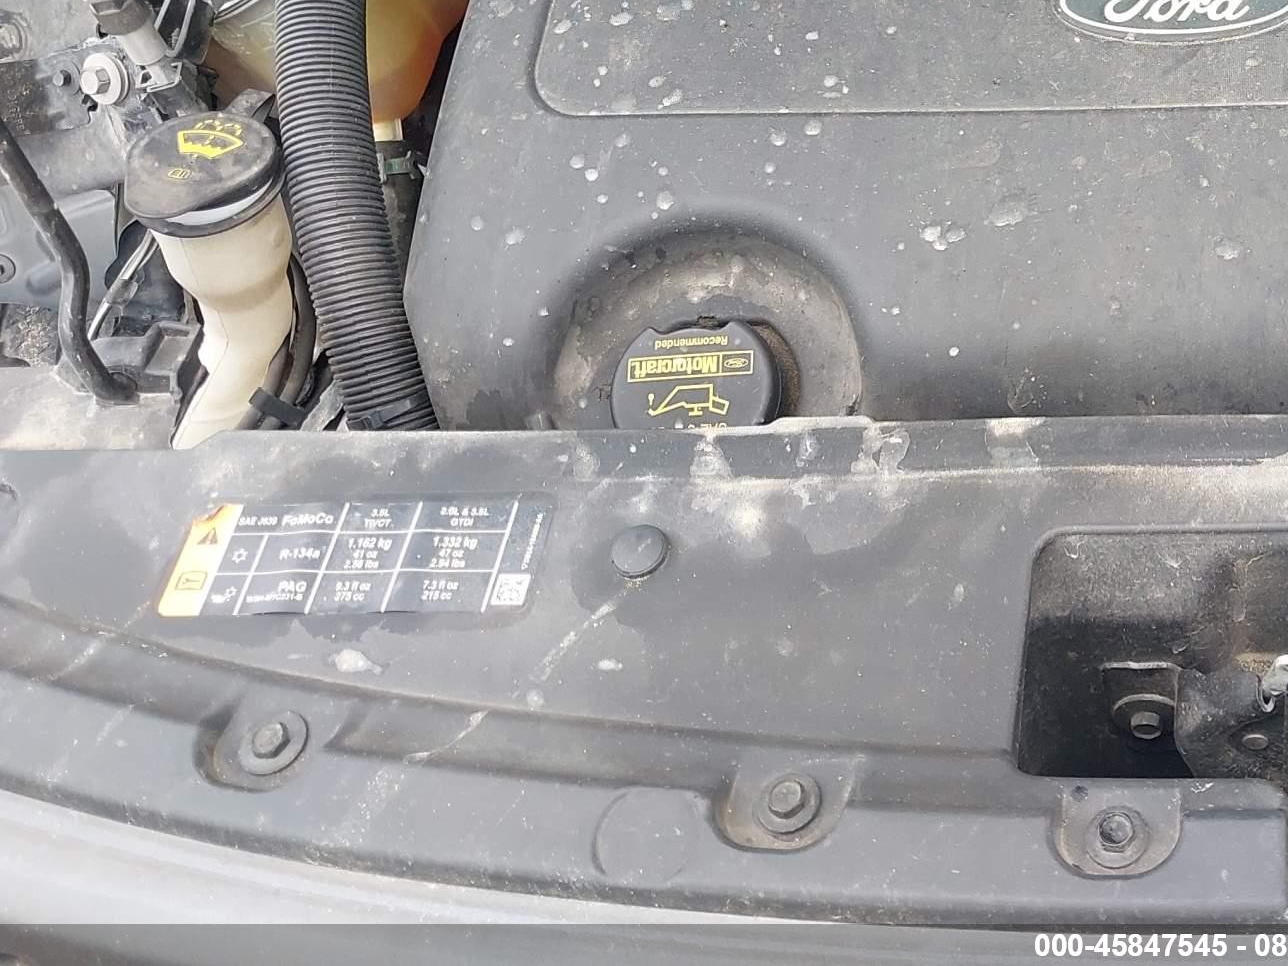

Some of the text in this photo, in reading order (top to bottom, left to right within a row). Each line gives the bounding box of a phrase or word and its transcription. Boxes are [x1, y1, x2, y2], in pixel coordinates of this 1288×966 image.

[654, 335, 729, 350] Recommended
[632, 354, 718, 379] Motorcraft
[281, 513, 334, 527] FoMoCo
[377, 537, 393, 552] kg
[433, 536, 479, 551] 1.332 kg
[279, 547, 321, 562] R-134a
[353, 549, 379, 560] 41 oz
[439, 548, 465, 559] 47 oz
[365, 559, 380, 570] lbs
[451, 558, 467, 569] lbs
[277, 580, 308, 594] PAG
[359, 581, 373, 592] oz
[423, 579, 438, 590] 7.3
[446, 580, 460, 591] oz
[352, 593, 366, 602] cc
[421, 590, 453, 601] 215 cc
